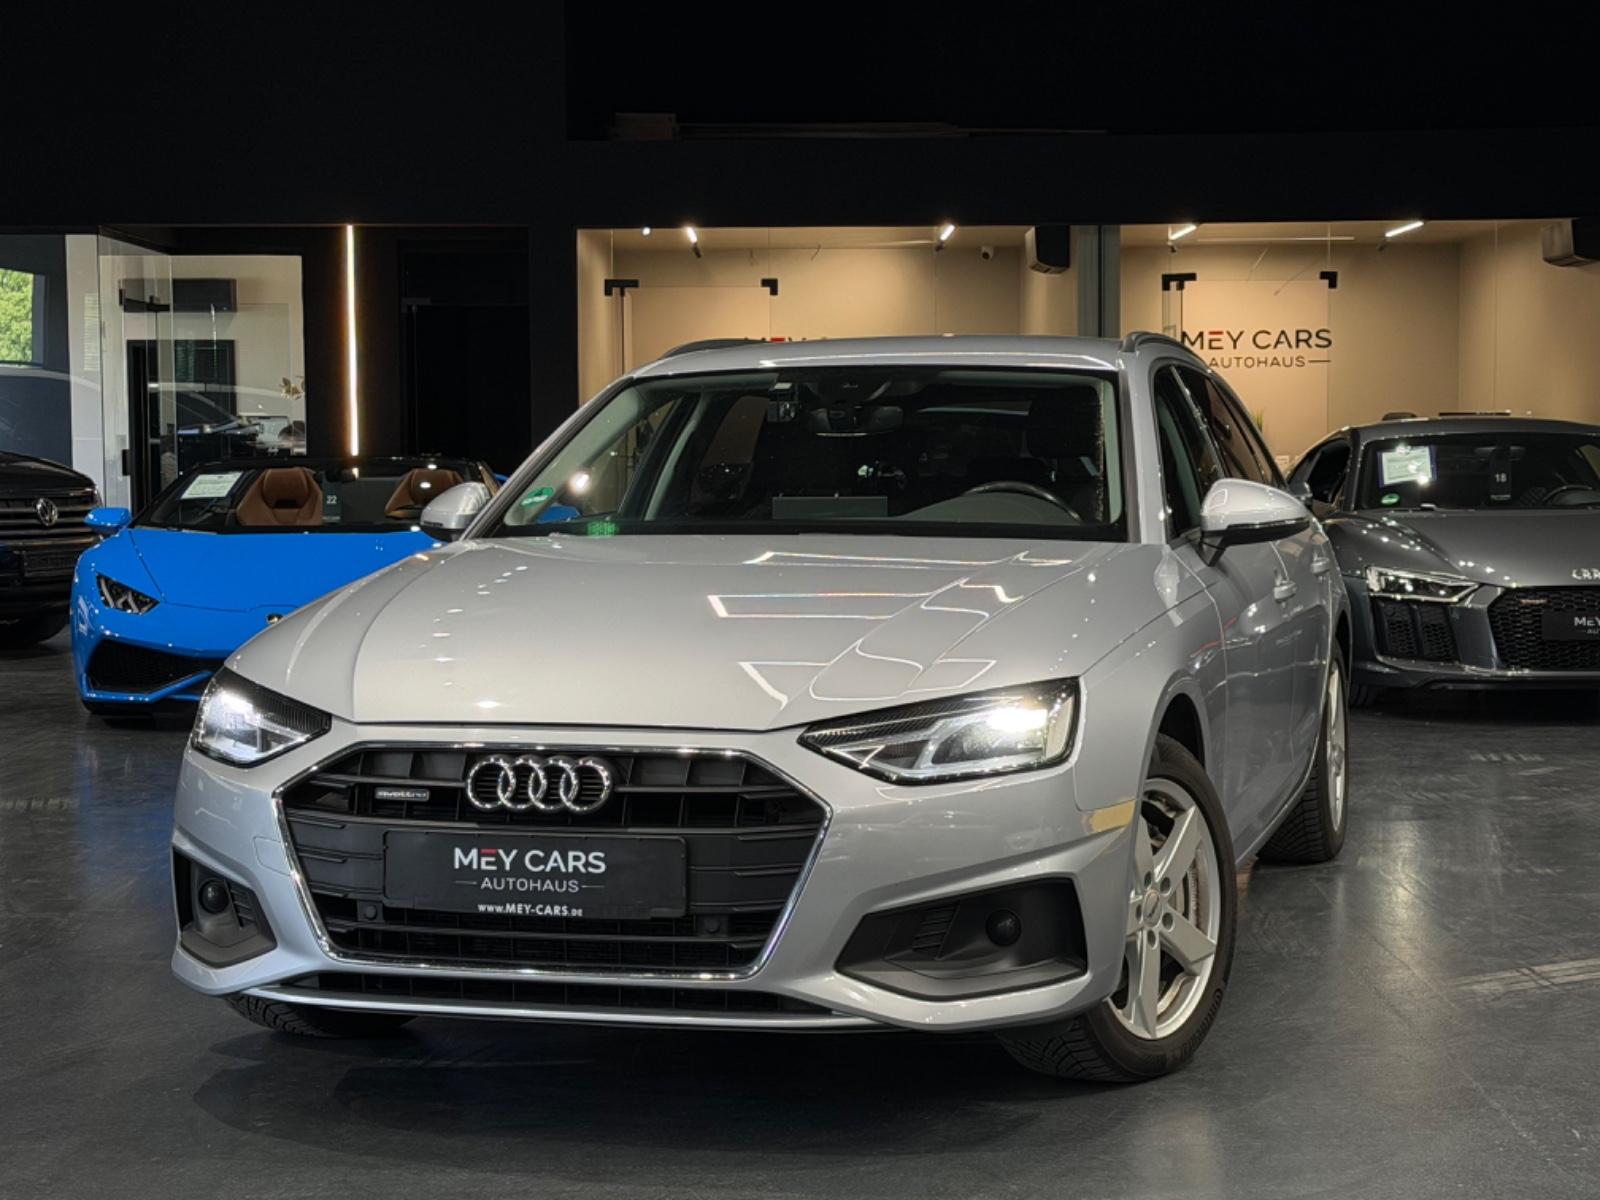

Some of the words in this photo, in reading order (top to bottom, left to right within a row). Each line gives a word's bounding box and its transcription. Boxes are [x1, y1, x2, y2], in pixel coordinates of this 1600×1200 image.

[1181, 330, 1245, 350] MEY
[1252, 329, 1333, 349] CARS
[1209, 355, 1306, 369] AUTOHAUS
[454, 847, 518, 871] MEY
[524, 849, 606, 874] CARS
[480, 877, 579, 893] AUTOHAUS
